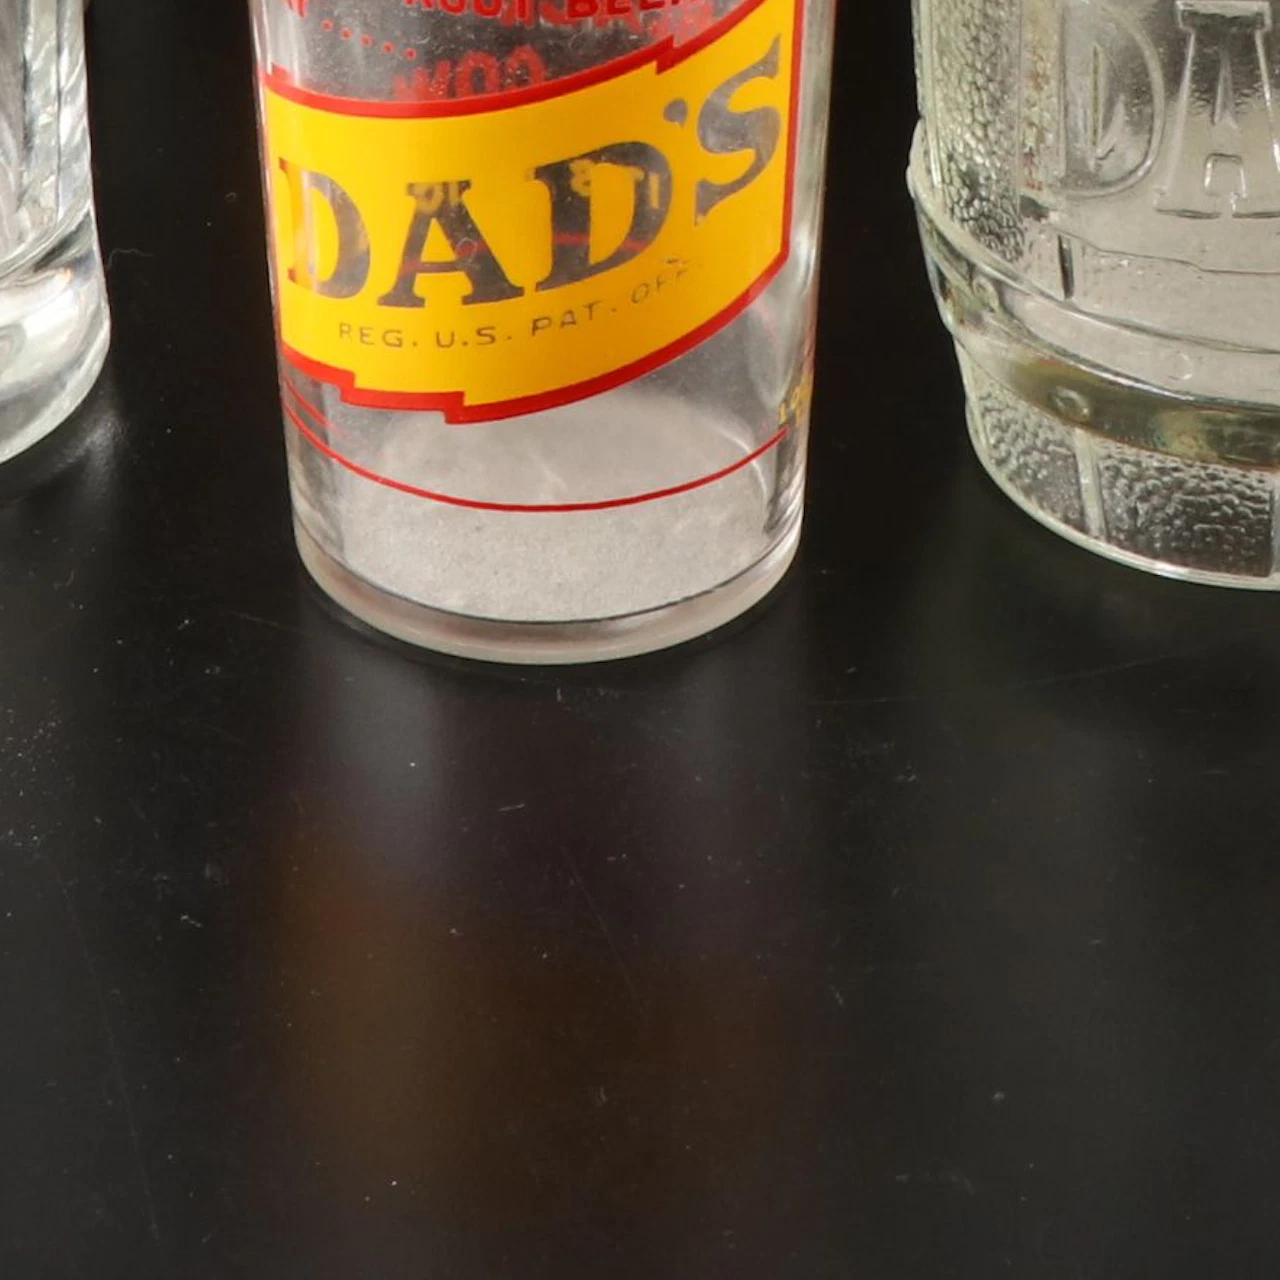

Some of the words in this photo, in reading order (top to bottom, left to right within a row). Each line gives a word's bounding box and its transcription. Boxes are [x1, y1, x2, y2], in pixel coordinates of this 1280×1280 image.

[277, 32, 782, 310] DAD'S
[339, 321, 419, 349] REG.
[435, 326, 512, 350] U.S.
[531, 300, 618, 337] PAT.
